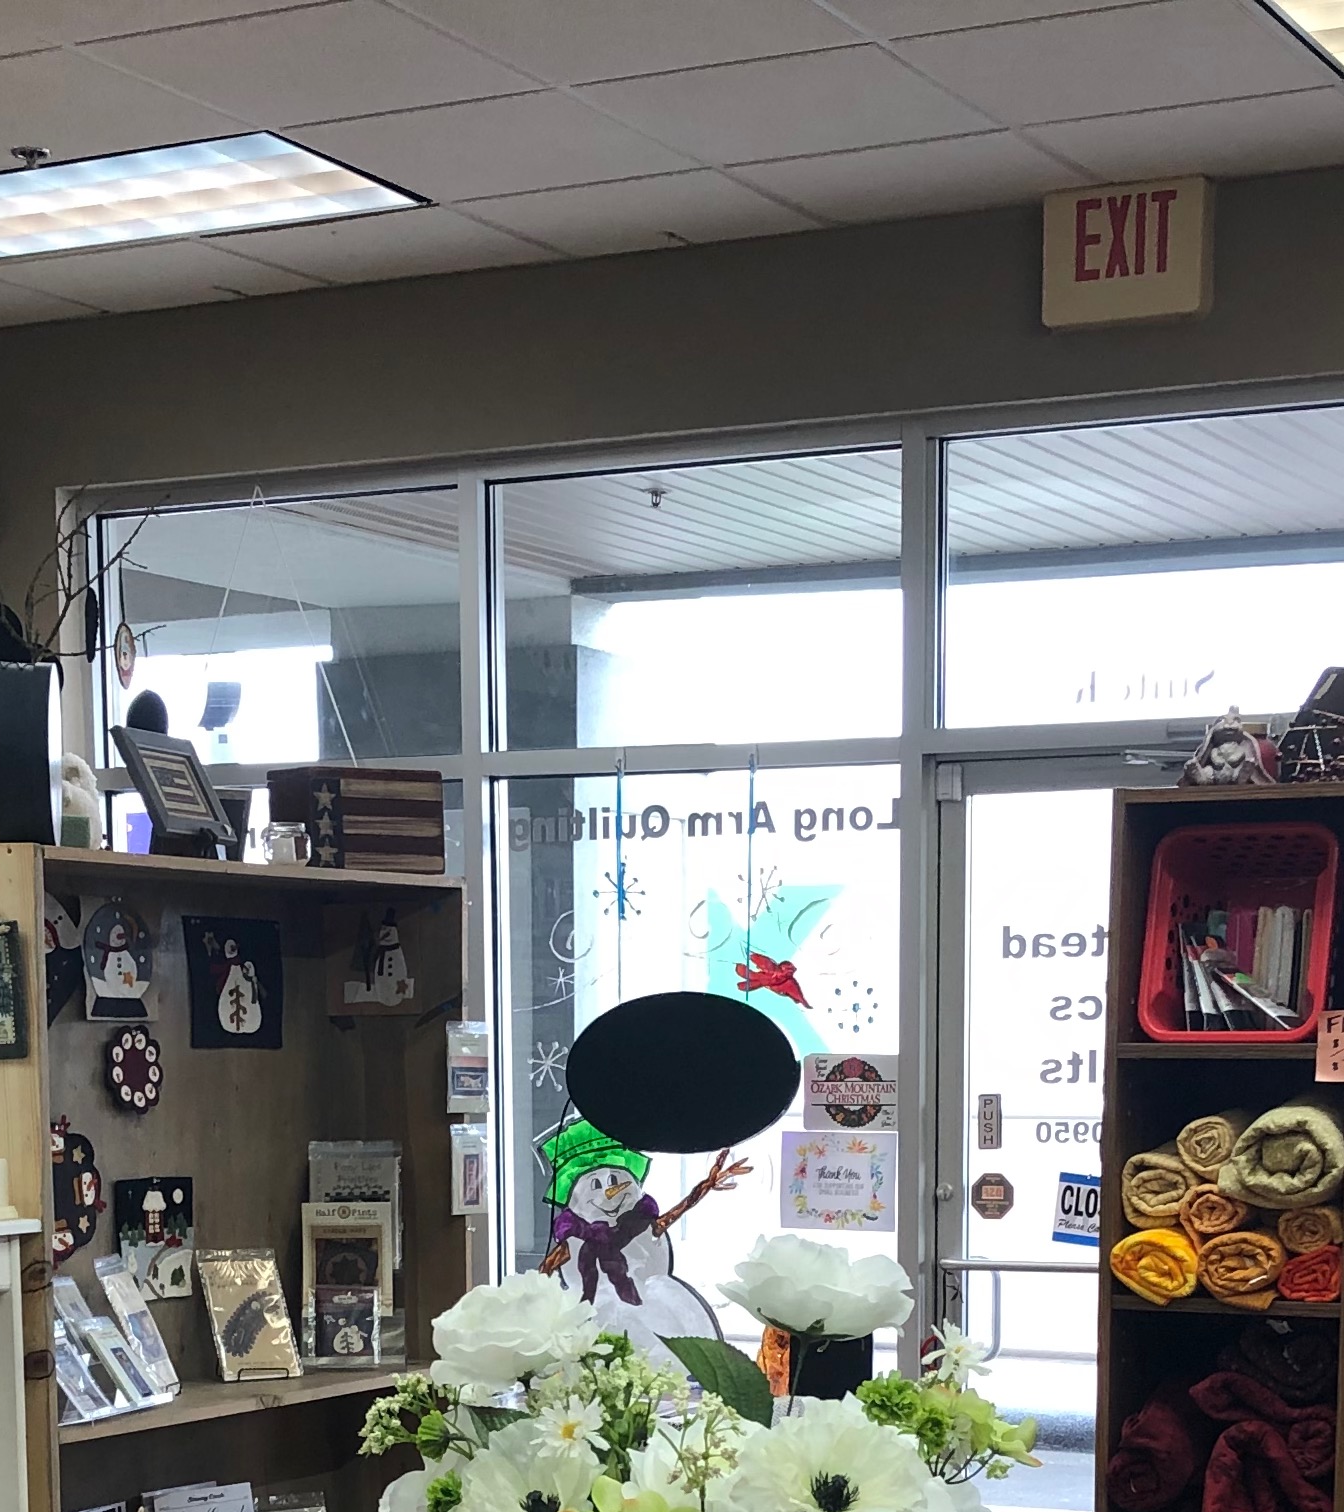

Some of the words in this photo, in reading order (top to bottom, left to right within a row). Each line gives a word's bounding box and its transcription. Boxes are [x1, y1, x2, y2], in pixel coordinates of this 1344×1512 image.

[1075, 190, 1177, 282] EXIT
[811, 1083, 842, 1094] OZARK
[845, 1082, 896, 1094] MOUNTAIN
[826, 1094, 881, 1104] CHRISTMAS
[983, 1098, 994, 1145] PUSH
[816, 1165, 842, 1181] Thank
[843, 1168, 861, 1182] You
[352, 1208, 377, 1216] Pints
[1058, 1219, 1084, 1230] Please
